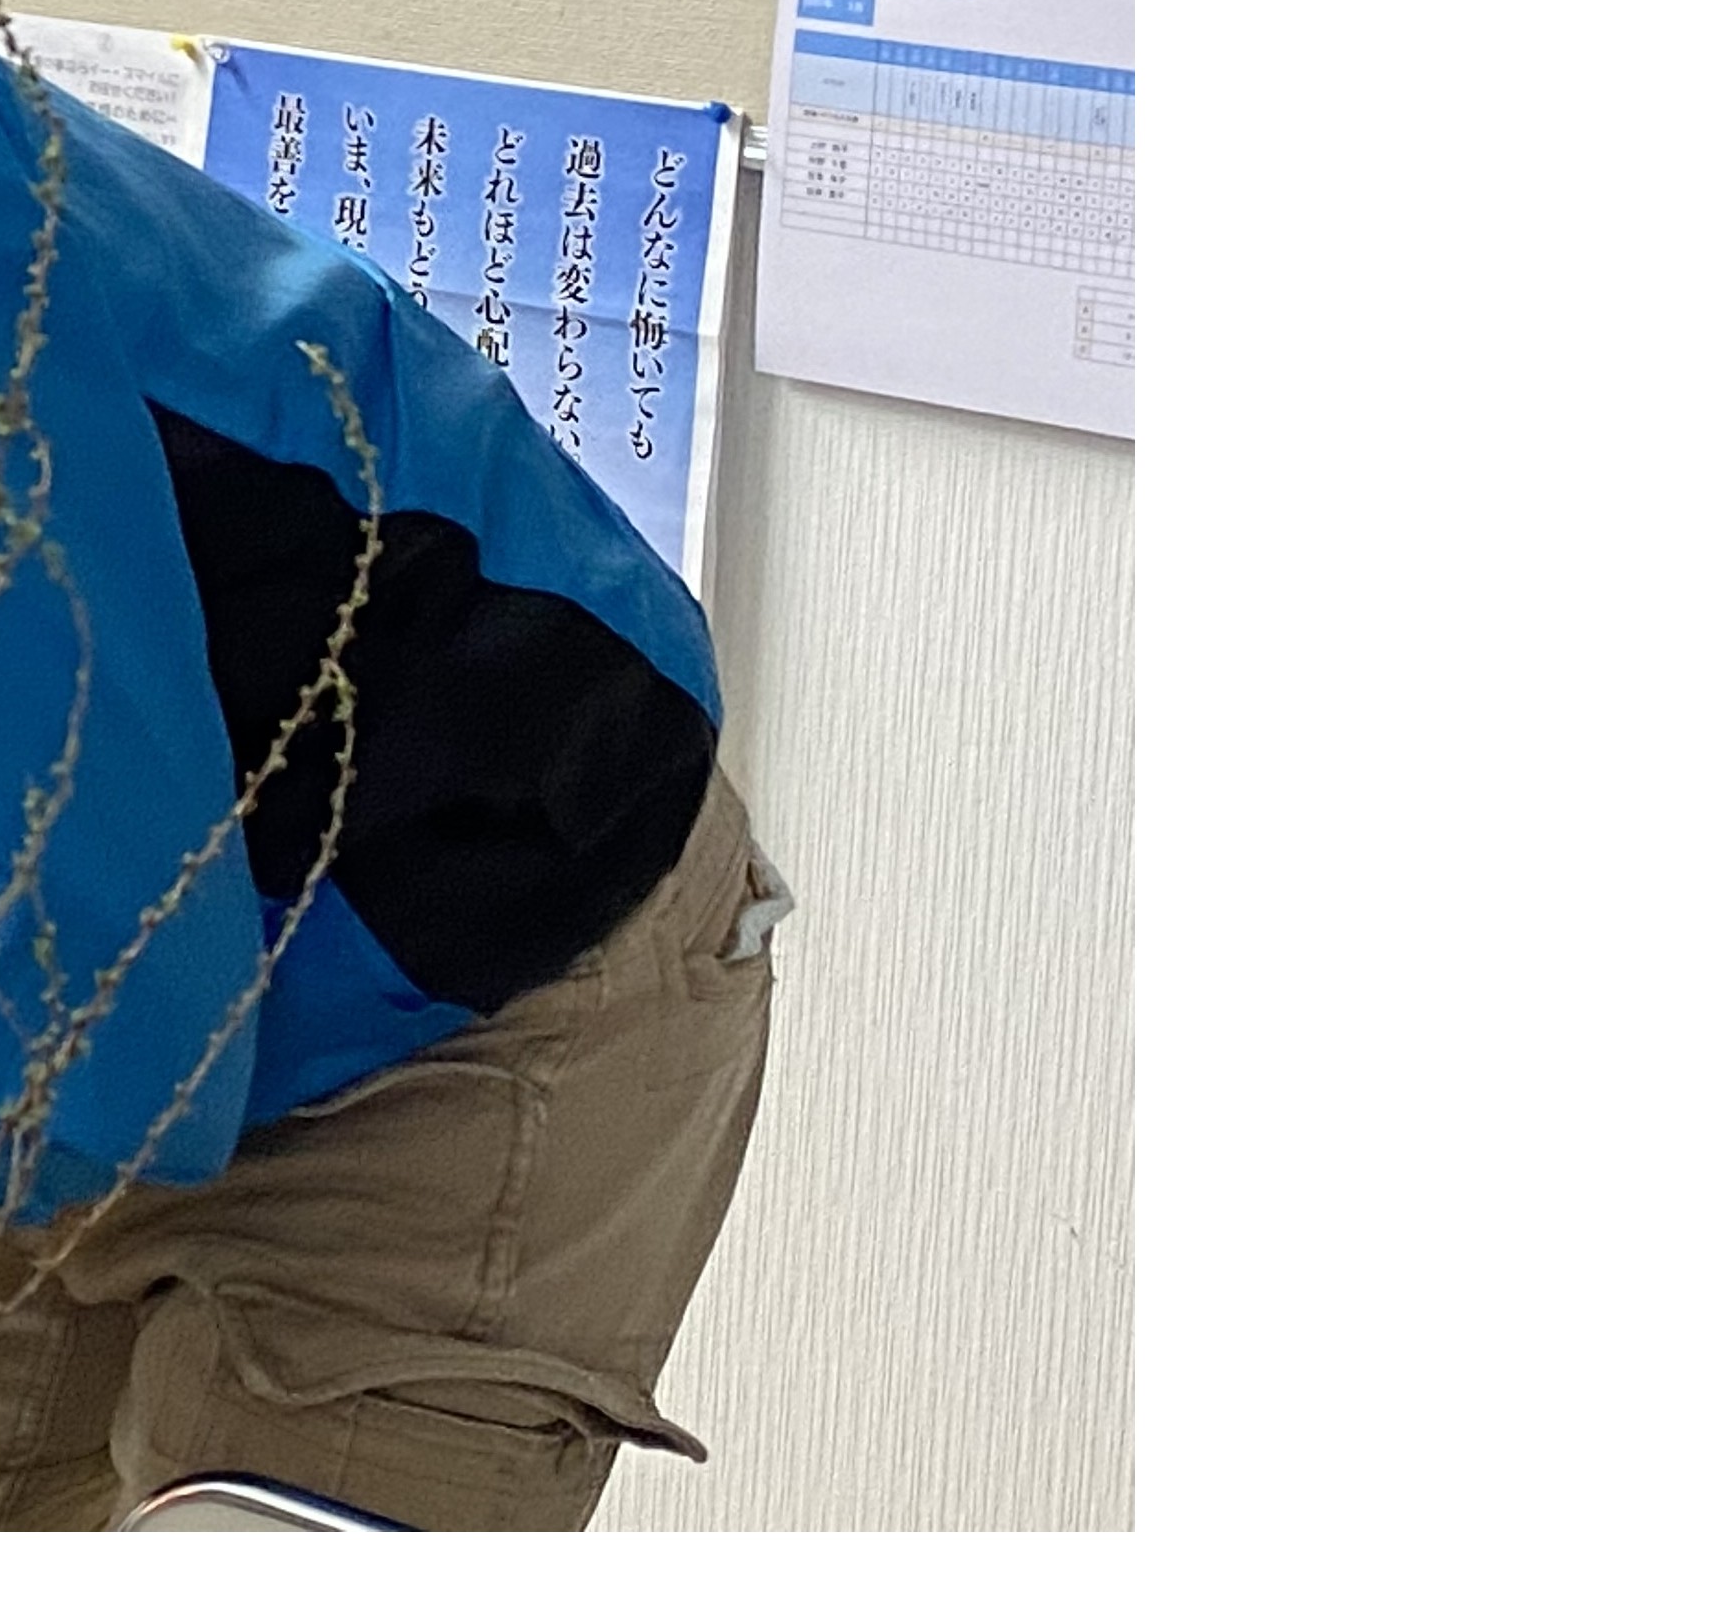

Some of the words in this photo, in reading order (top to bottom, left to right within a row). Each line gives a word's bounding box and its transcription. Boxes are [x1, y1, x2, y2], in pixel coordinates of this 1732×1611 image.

[269, 94, 306, 214] 最善を
[334, 105, 375, 249] いま、現
[475, 126, 523, 368] どれほど心配
[629, 149, 685, 461] どんなに悔いても
